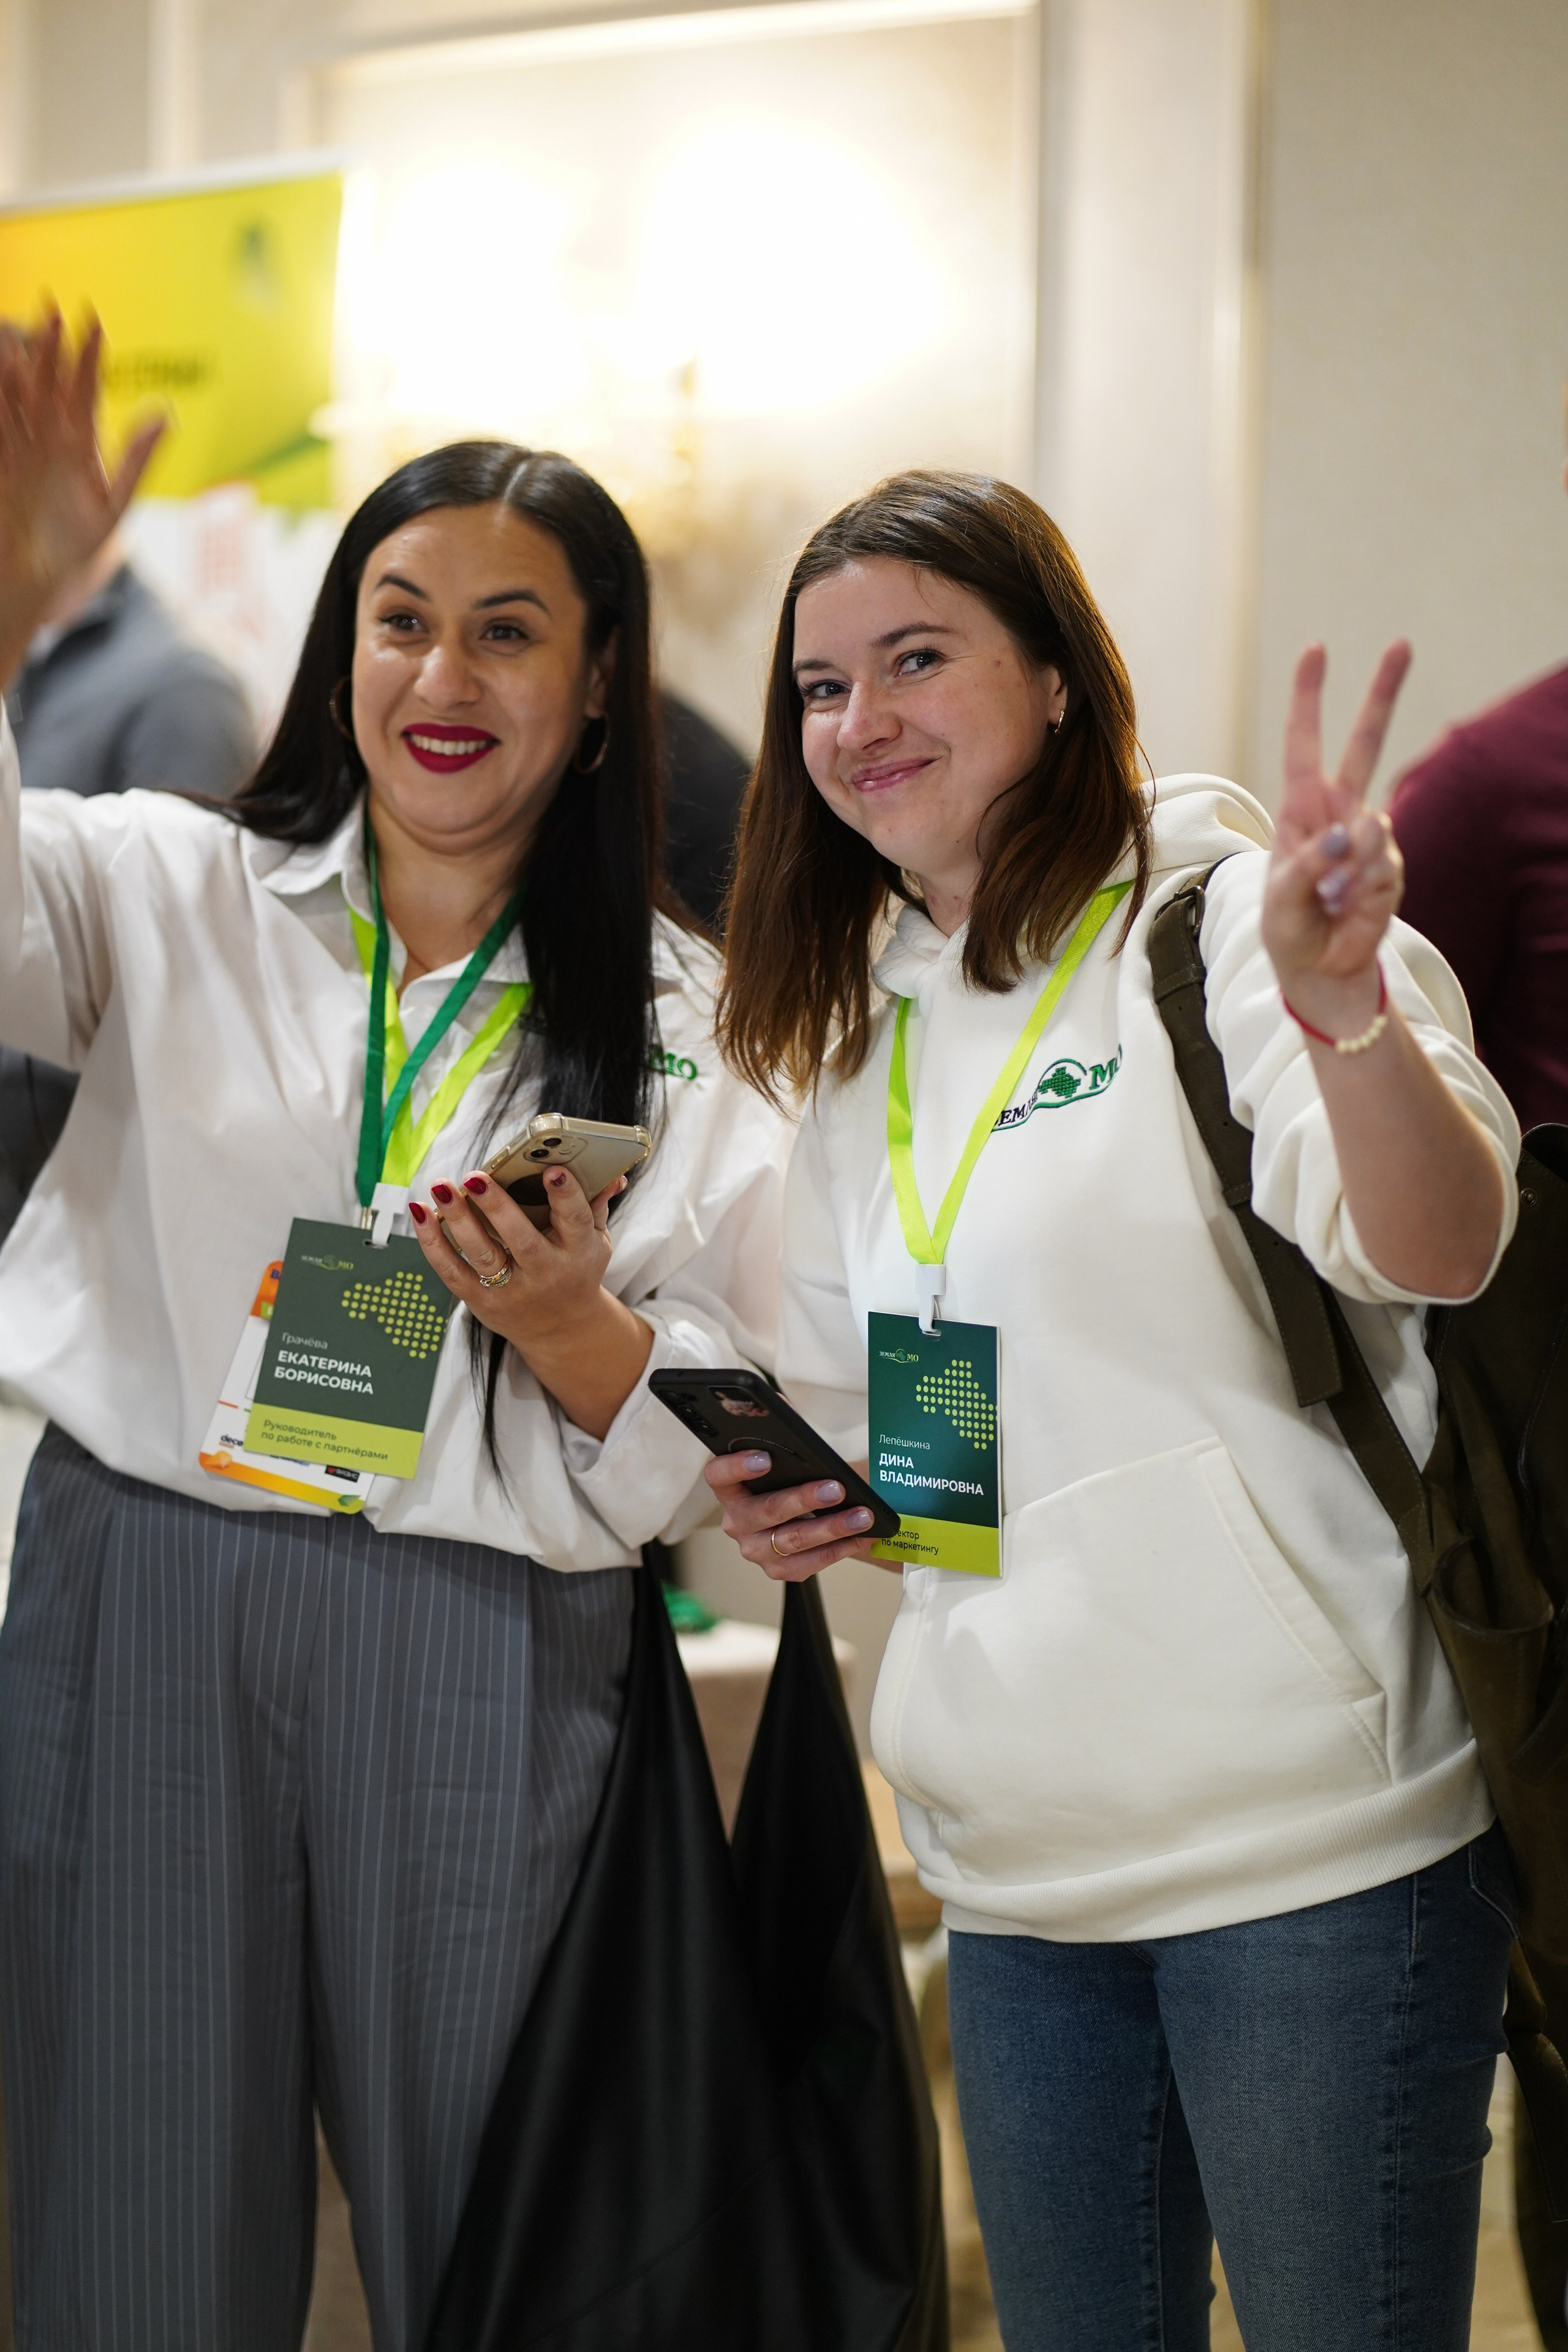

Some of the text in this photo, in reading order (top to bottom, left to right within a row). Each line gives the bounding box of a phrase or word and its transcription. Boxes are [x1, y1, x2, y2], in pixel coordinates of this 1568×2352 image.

[994, 1088, 1038, 1126] ЕМЛЯ
[282, 1332, 328, 1349] Грачёва
[277, 1349, 372, 1378] ЕКАТЕРИНА
[907, 1353, 919, 1362] МО
[274, 1365, 374, 1395] БОРИСОВНА
[264, 1419, 337, 1441] Руководитель
[261, 1431, 275, 1440] по
[276, 1434, 313, 1447] работе
[323, 1444, 389, 1460] партнёрами
[879, 1434, 930, 1450] Лепёшкина
[879, 1453, 914, 1469] ДИНА
[880, 1469, 984, 1496] ВЛАДИМИРОВНА
[897, 1530, 920, 1541] ектор
[893, 1540, 940, 1556] маркетингу
